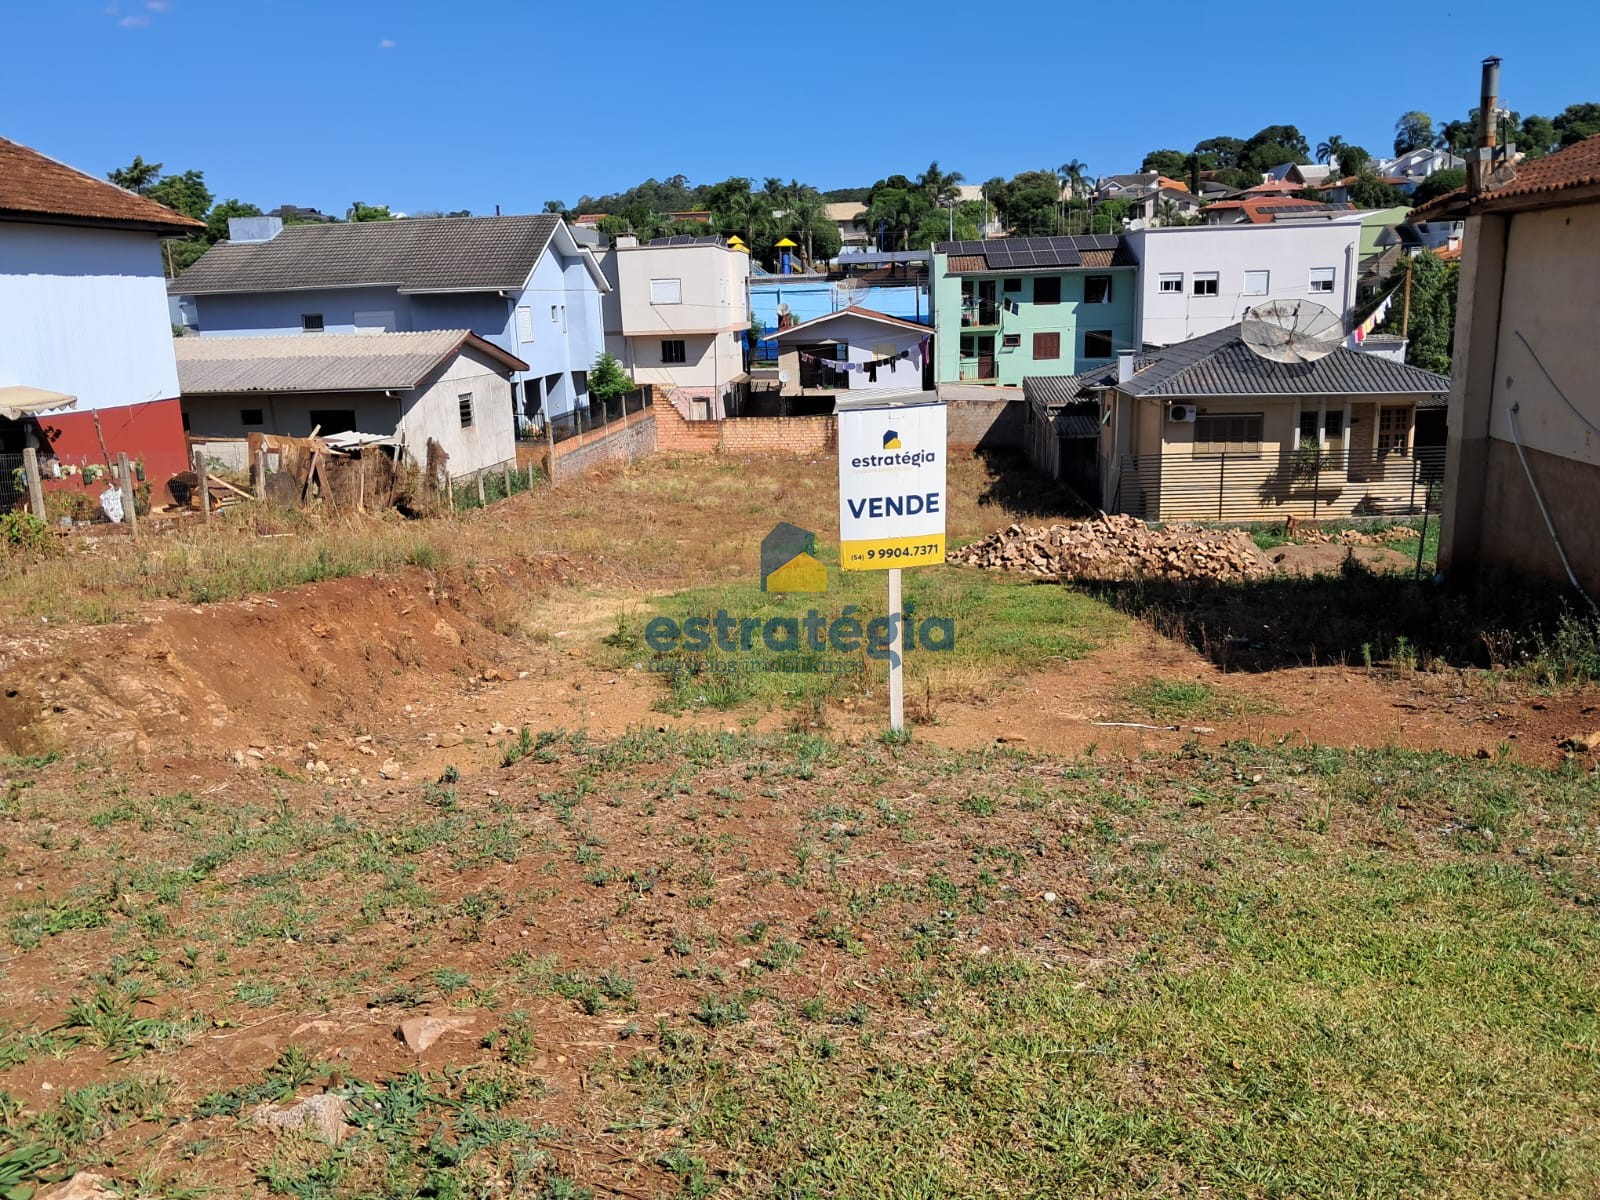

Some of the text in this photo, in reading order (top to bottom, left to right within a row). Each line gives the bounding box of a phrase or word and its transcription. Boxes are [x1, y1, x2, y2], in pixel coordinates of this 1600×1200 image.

[851, 449, 935, 468] estratégia
[847, 492, 940, 519] VENDE
[851, 543, 939, 562] (54) 9 9904.7371
